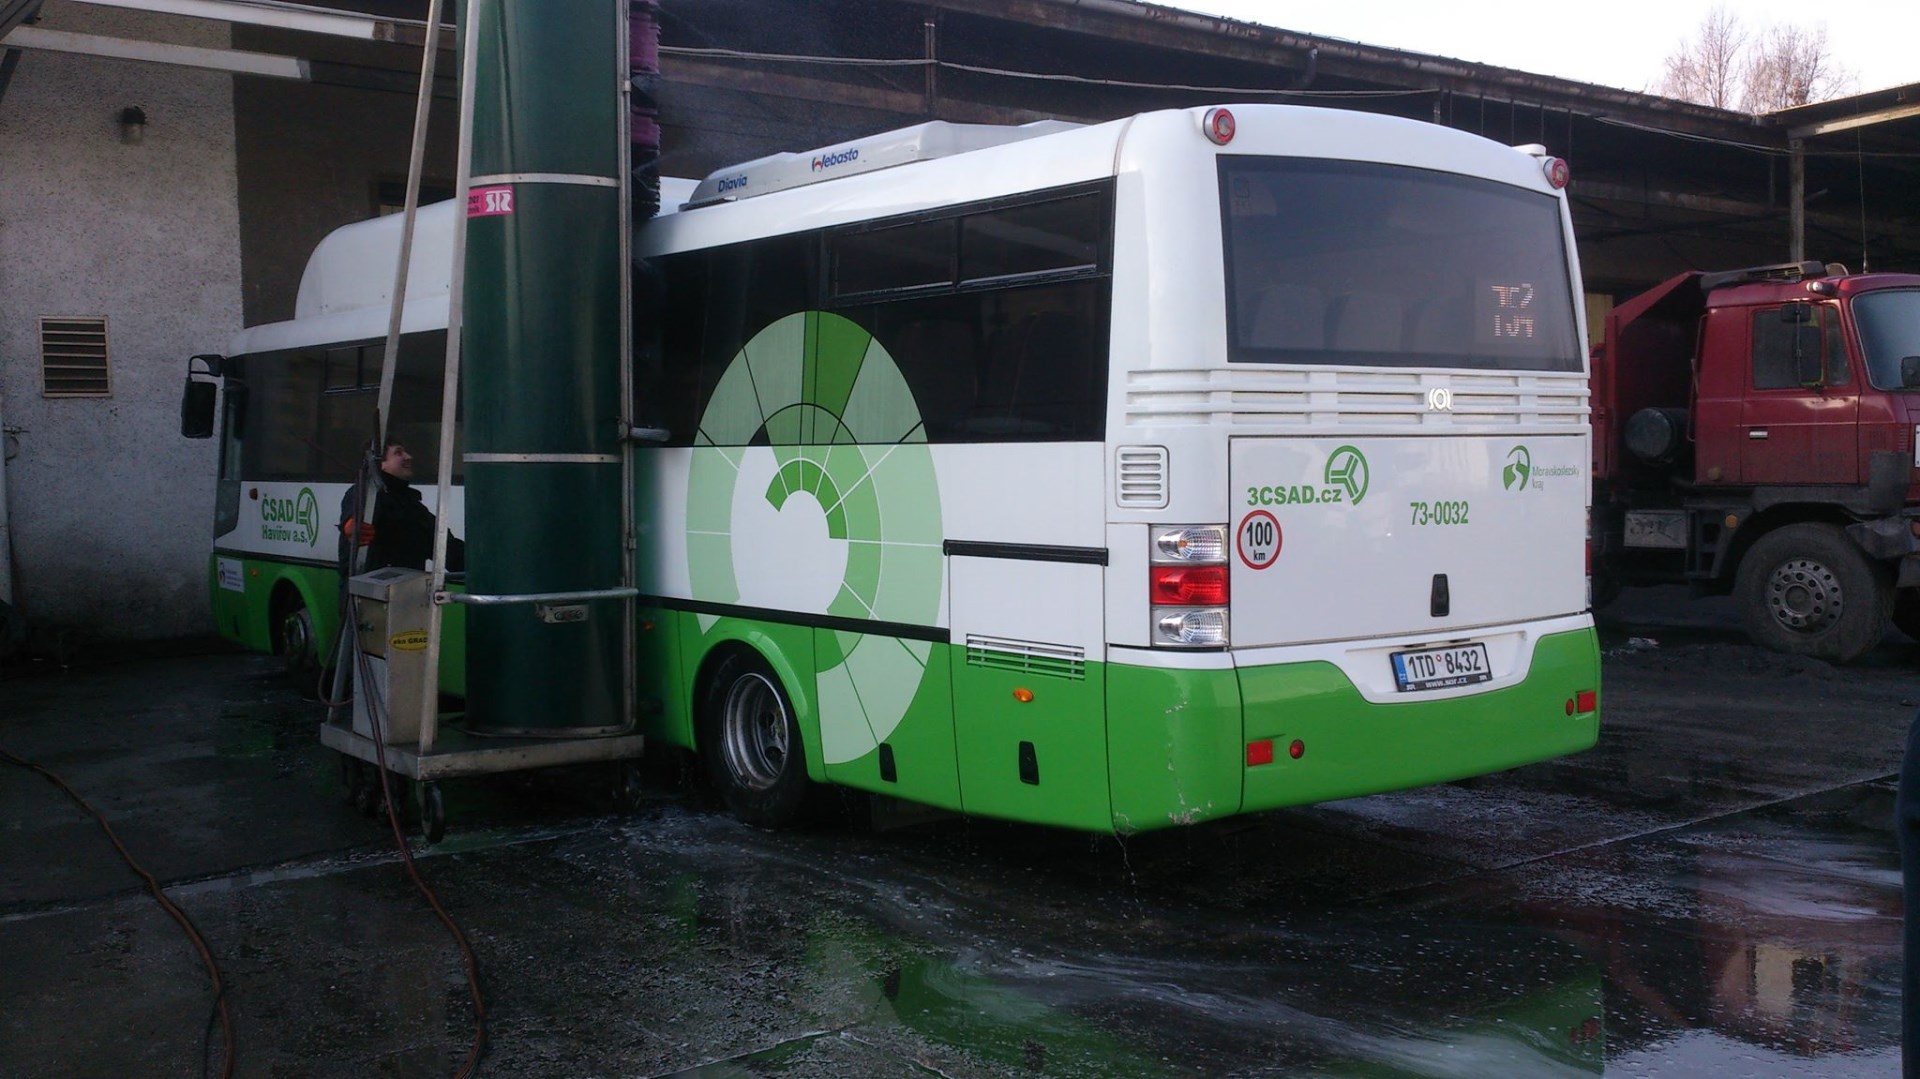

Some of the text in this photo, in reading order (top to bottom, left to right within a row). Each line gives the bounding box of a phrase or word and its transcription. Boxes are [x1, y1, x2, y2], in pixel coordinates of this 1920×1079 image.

[812, 149, 858, 172] Webasto
[719, 175, 747, 192] Diavia
[1247, 485, 1342, 506] 3CSAD.cz
[262, 493, 294, 522] ČSAD
[1410, 501, 1469, 525] 73-0032
[293, 531, 308, 543] a.s.
[1246, 521, 1273, 546] 100
[1253, 550, 1266, 561] km
[1408, 649, 1482, 679] 1TD 8432
